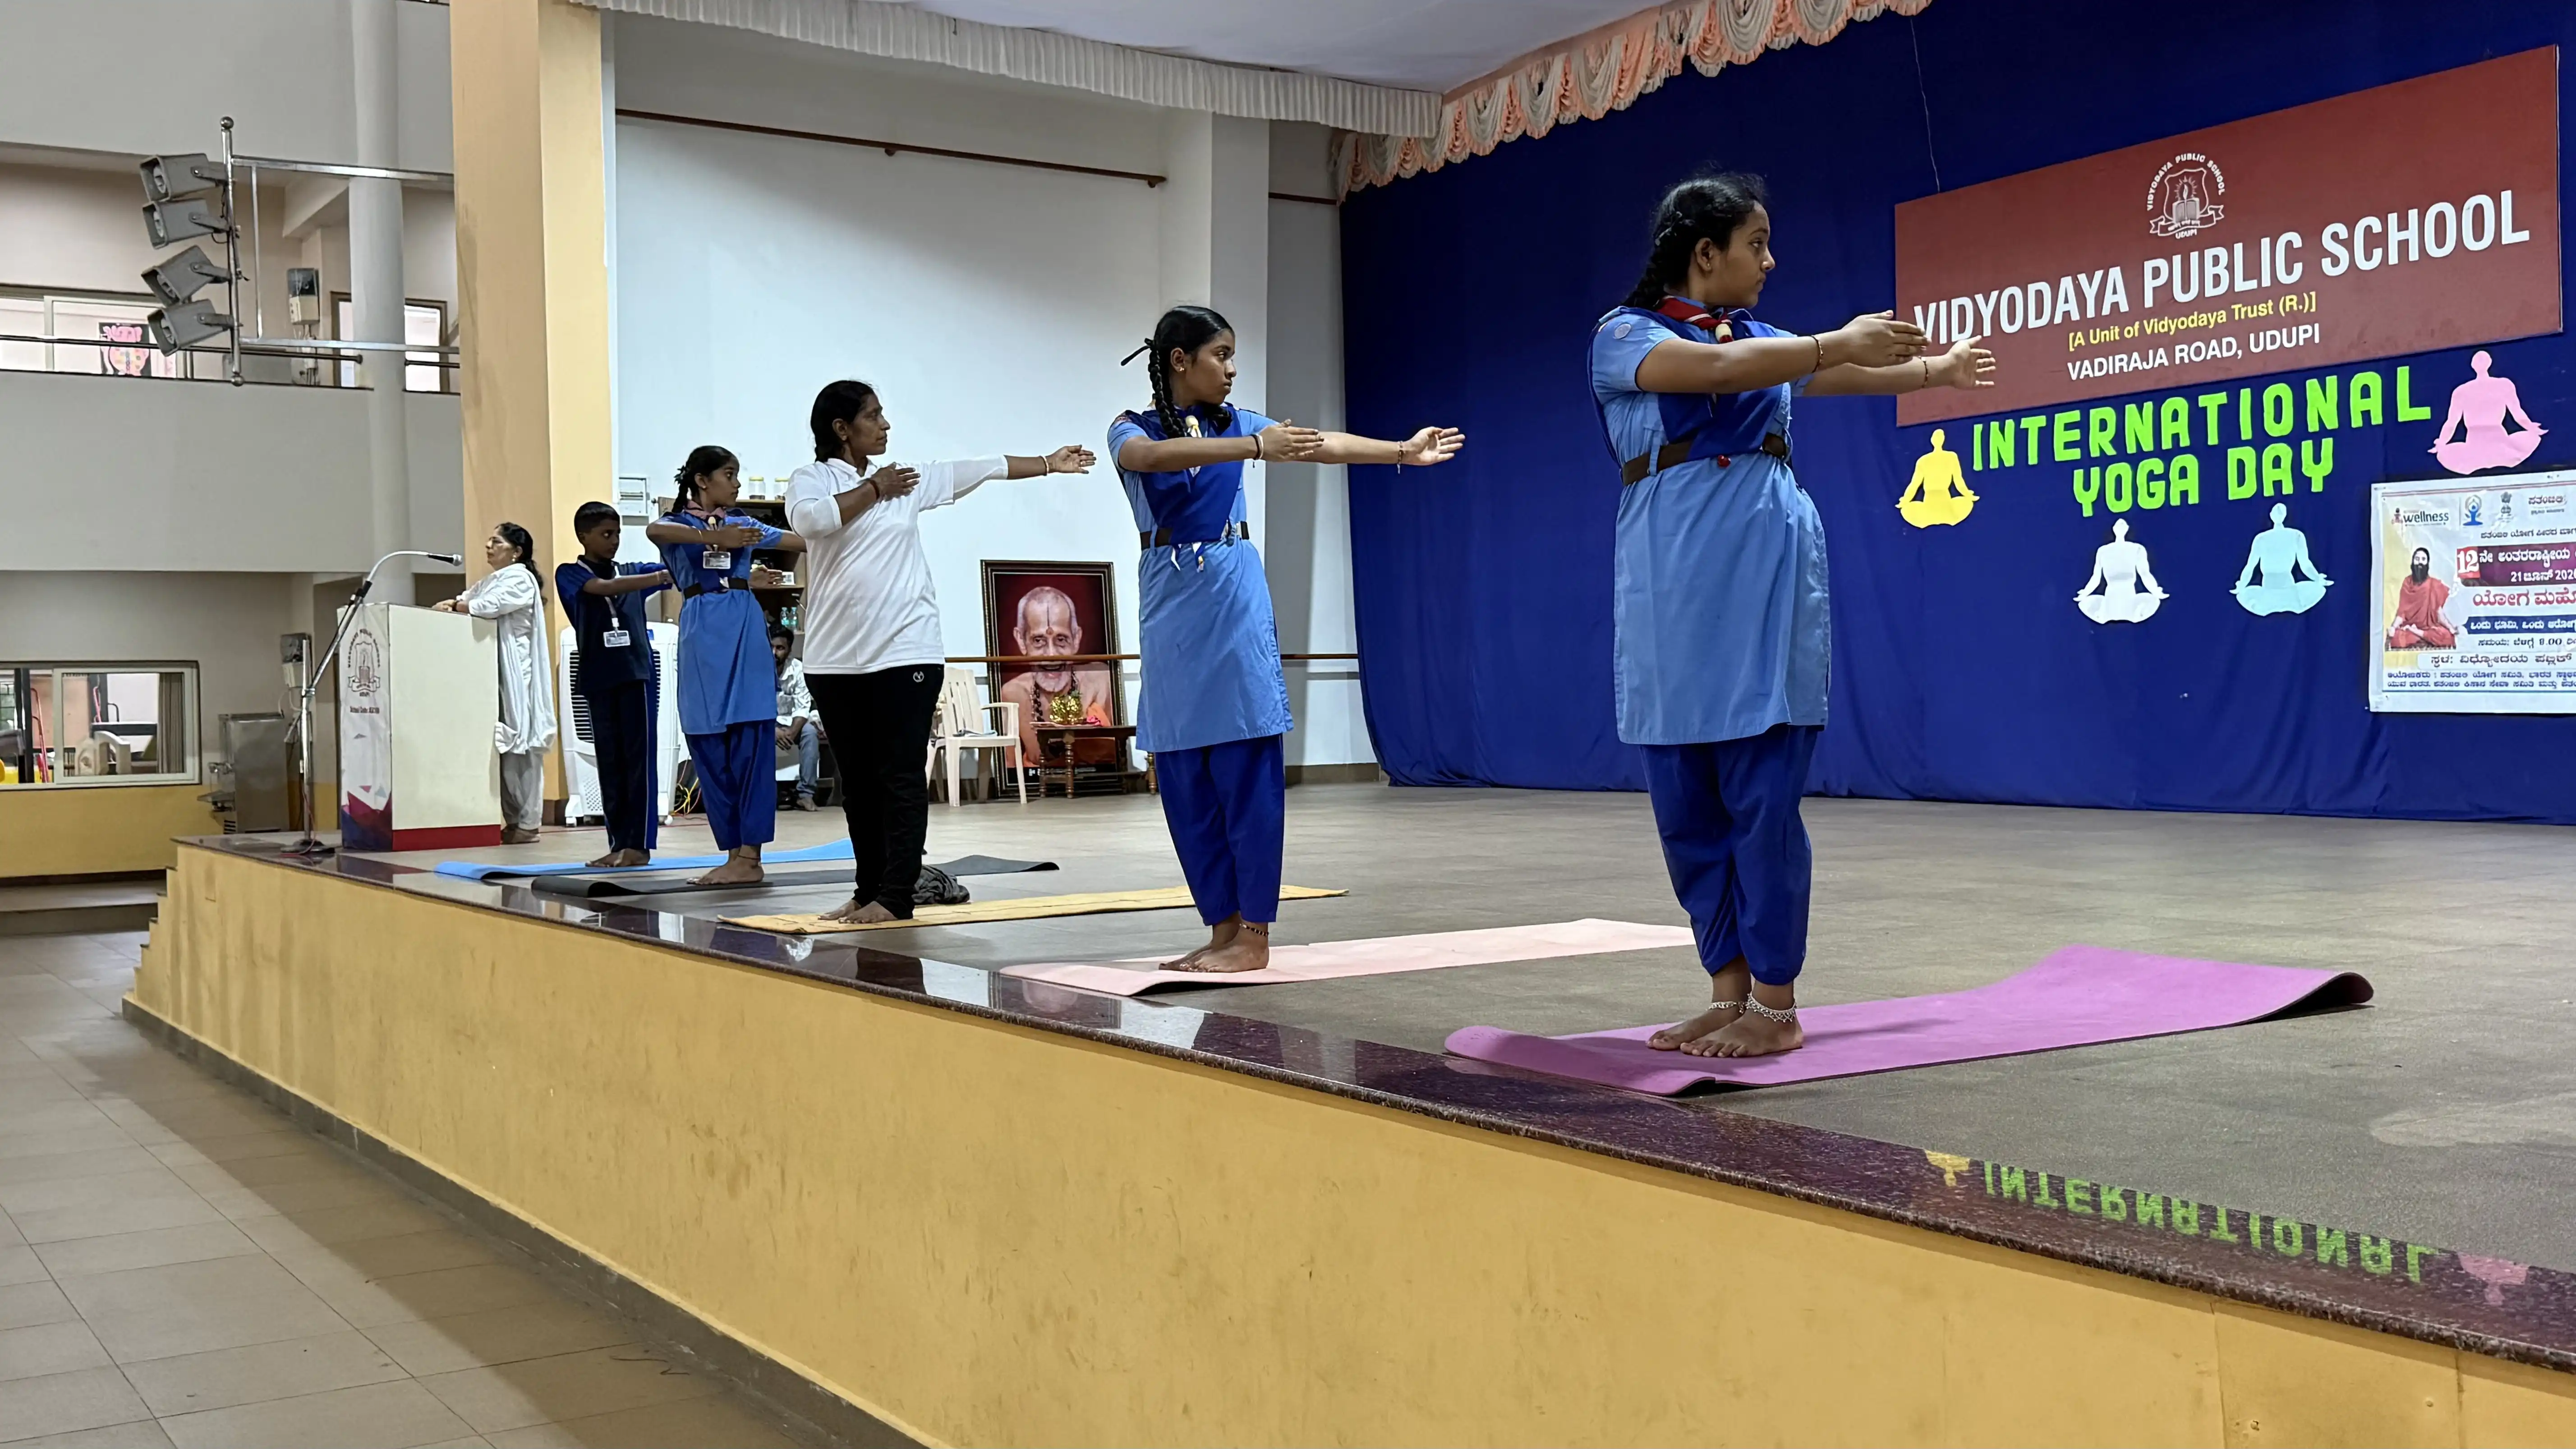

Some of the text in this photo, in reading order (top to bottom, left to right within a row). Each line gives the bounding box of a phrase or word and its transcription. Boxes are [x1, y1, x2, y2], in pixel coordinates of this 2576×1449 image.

[2147, 153, 2226, 211] VIDYODAYA PUBLIC SCHOOL
[2175, 228, 2197, 239] UDUPI
[1914, 189, 2530, 344] VIDYODAYA PUBLIC SCHOOL
[2069, 291, 2317, 352] [A Unit of Vidyodaya Trust (R.)]
[2067, 322, 2320, 381] VADIRAJA ROAD, UDUPI
[1974, 367, 2432, 472] INTERNATIONAL
[2075, 438, 2334, 516] YOGA DAY
[2403, 511, 2449, 523] wellness
[2473, 589, 2530, 606] ಯೋಗ
[2511, 571, 2522, 582] 21
[2523, 569, 2554, 581] ಜೂನ್
